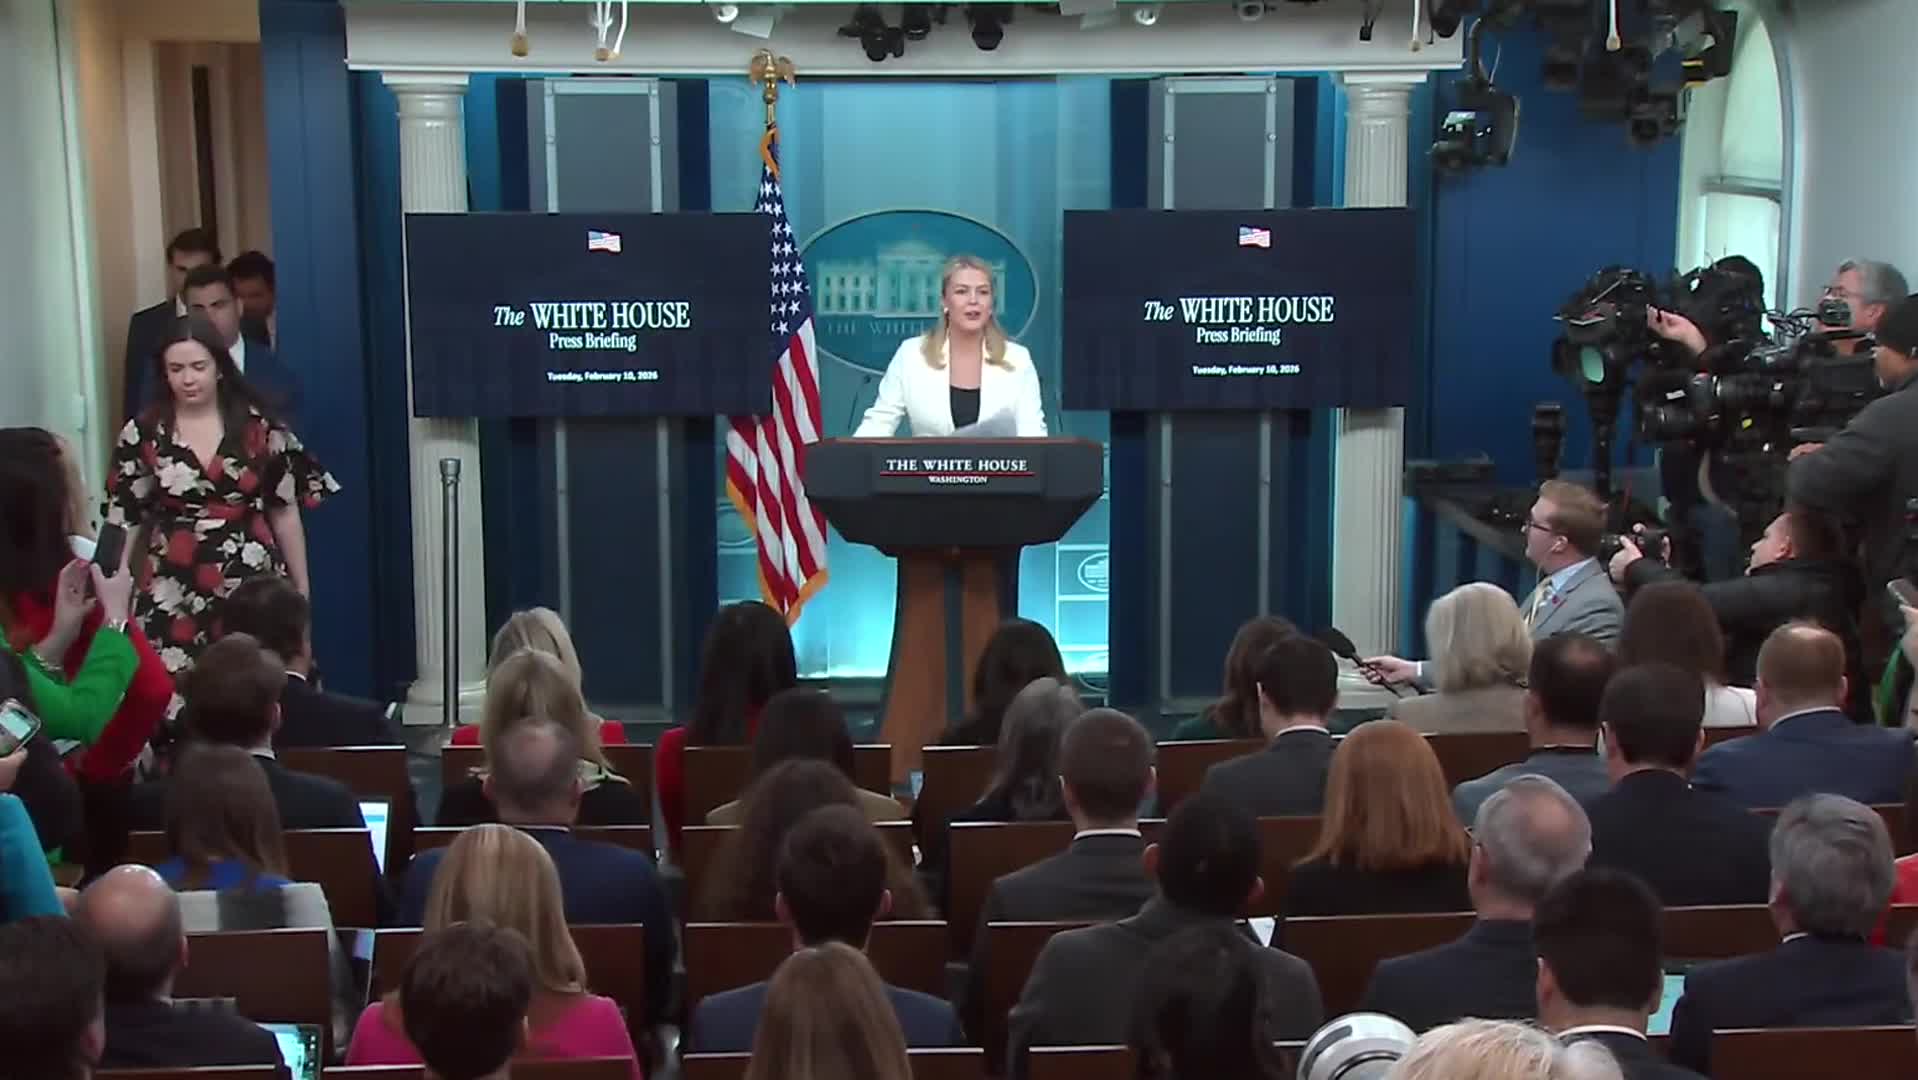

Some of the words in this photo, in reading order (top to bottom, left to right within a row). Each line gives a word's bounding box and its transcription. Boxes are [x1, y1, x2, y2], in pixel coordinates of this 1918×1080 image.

[494, 306, 525, 326] The
[530, 302, 607, 329] WHITE
[611, 302, 691, 328] HOUSE
[1144, 301, 1174, 321] The
[1179, 297, 1253, 323] WHITE
[1257, 296, 1334, 322] HOUSE
[550, 333, 583, 349] Press
[585, 332, 638, 352] Briefing
[1196, 327, 1229, 344] Press
[1231, 326, 1281, 346] Briefing
[547, 371, 584, 382] Tuesday,
[584, 371, 621, 382] February
[637, 371, 658, 380] 2026
[1193, 365, 1227, 376] Tuesday,
[1228, 364, 1264, 376] February
[1280, 364, 1300, 374] 2026
[886, 459, 917, 471] THE
[923, 459, 973, 471] WHITE
[978, 459, 1028, 471] HOUSE
[928, 475, 988, 484] WASHINGTON
